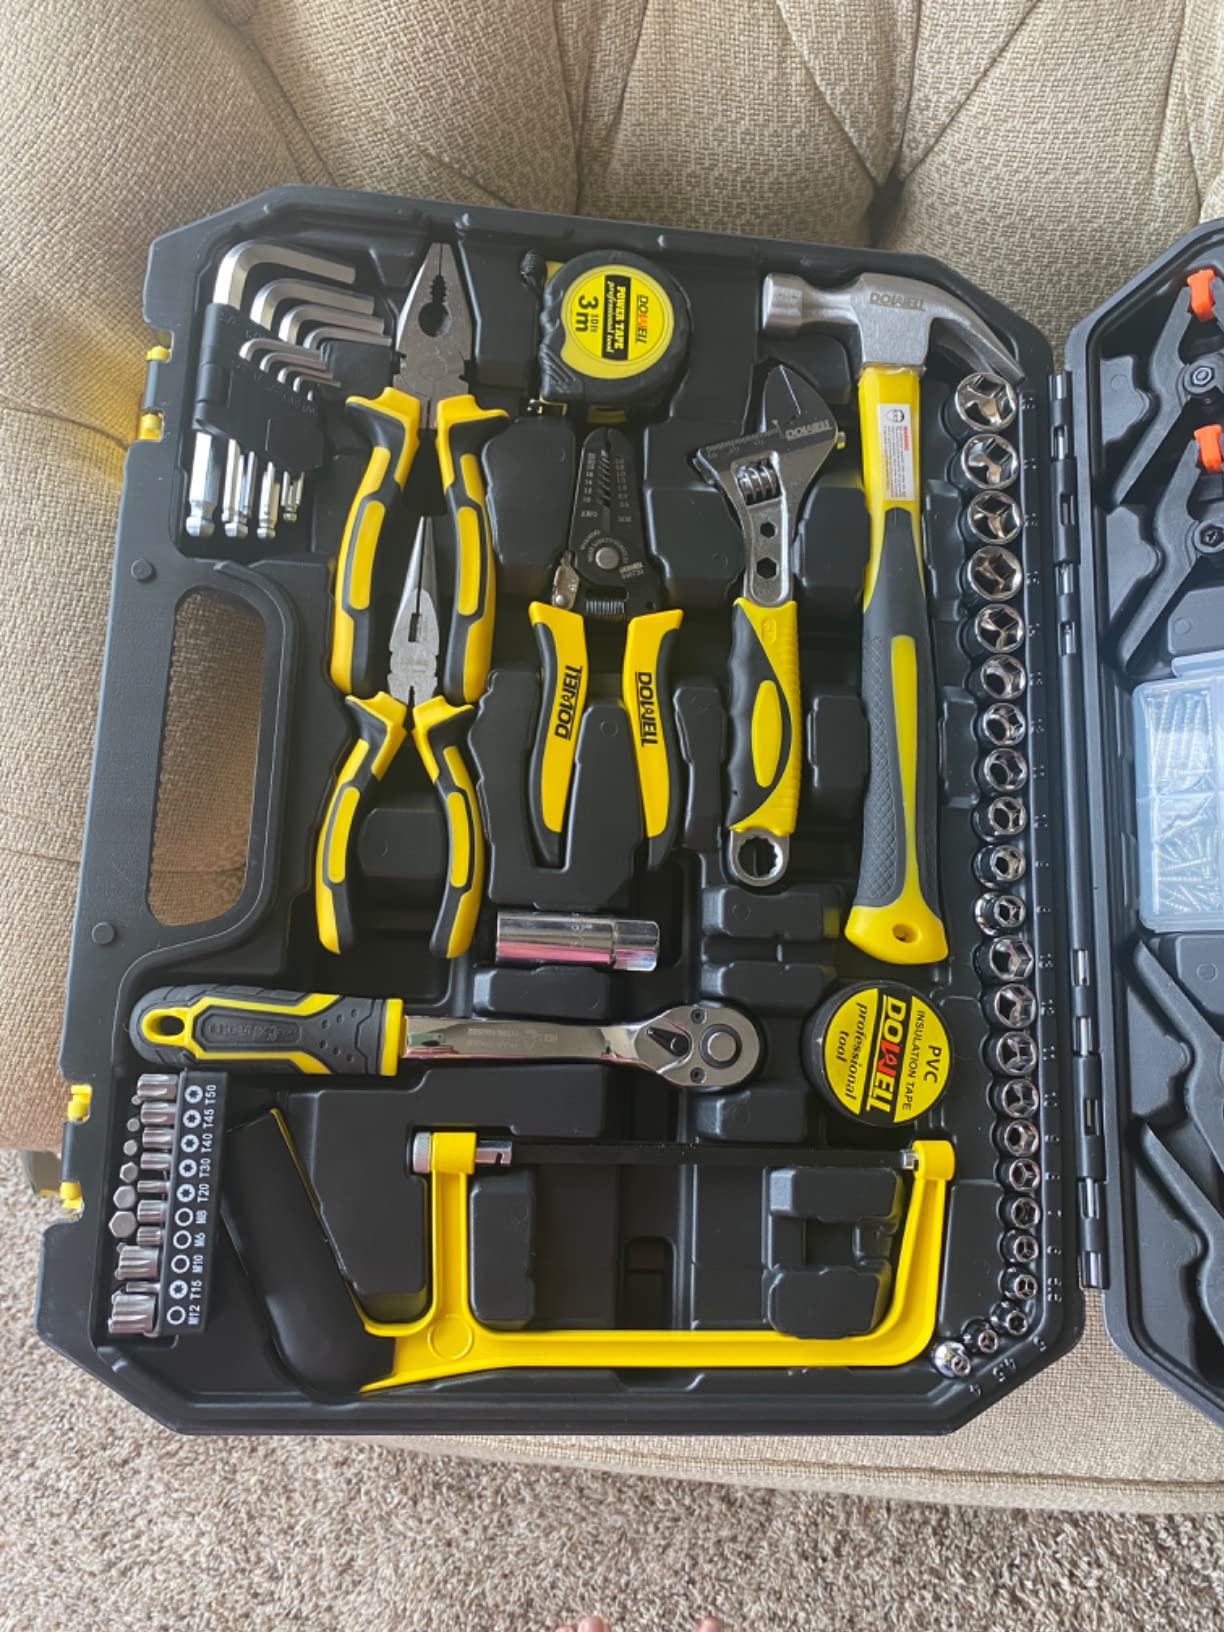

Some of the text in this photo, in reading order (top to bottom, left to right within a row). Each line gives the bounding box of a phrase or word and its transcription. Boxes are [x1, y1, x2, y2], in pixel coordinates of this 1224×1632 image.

[870, 292, 927, 312] DOWELL
[575, 295, 599, 332] 3 m
[606, 281, 616, 354] professional tool
[614, 286, 626, 349] POWER TAPE
[635, 294, 649, 345] DOWELL
[785, 419, 832, 441] DOWELL
[554, 664, 583, 741] DOWELL
[635, 671, 659, 748] DOWELL
[836, 1002, 868, 1101] professional tool
[866, 995, 907, 1113] DOWELL
[902, 1010, 926, 1112] INSULATION TAPE
[923, 1044, 943, 1084] PVC
[205, 1084, 217, 1105] T50
[202, 1108, 215, 1129] T45
[201, 1133, 213, 1153] T40
[199, 1158, 211, 1178] T30
[197, 1183, 210, 1204] T20
[195, 1209, 207, 1224] M8
[193, 1232, 206, 1247] M6
[192, 1254, 204, 1274] M10
[187, 1305, 201, 1325] M12
